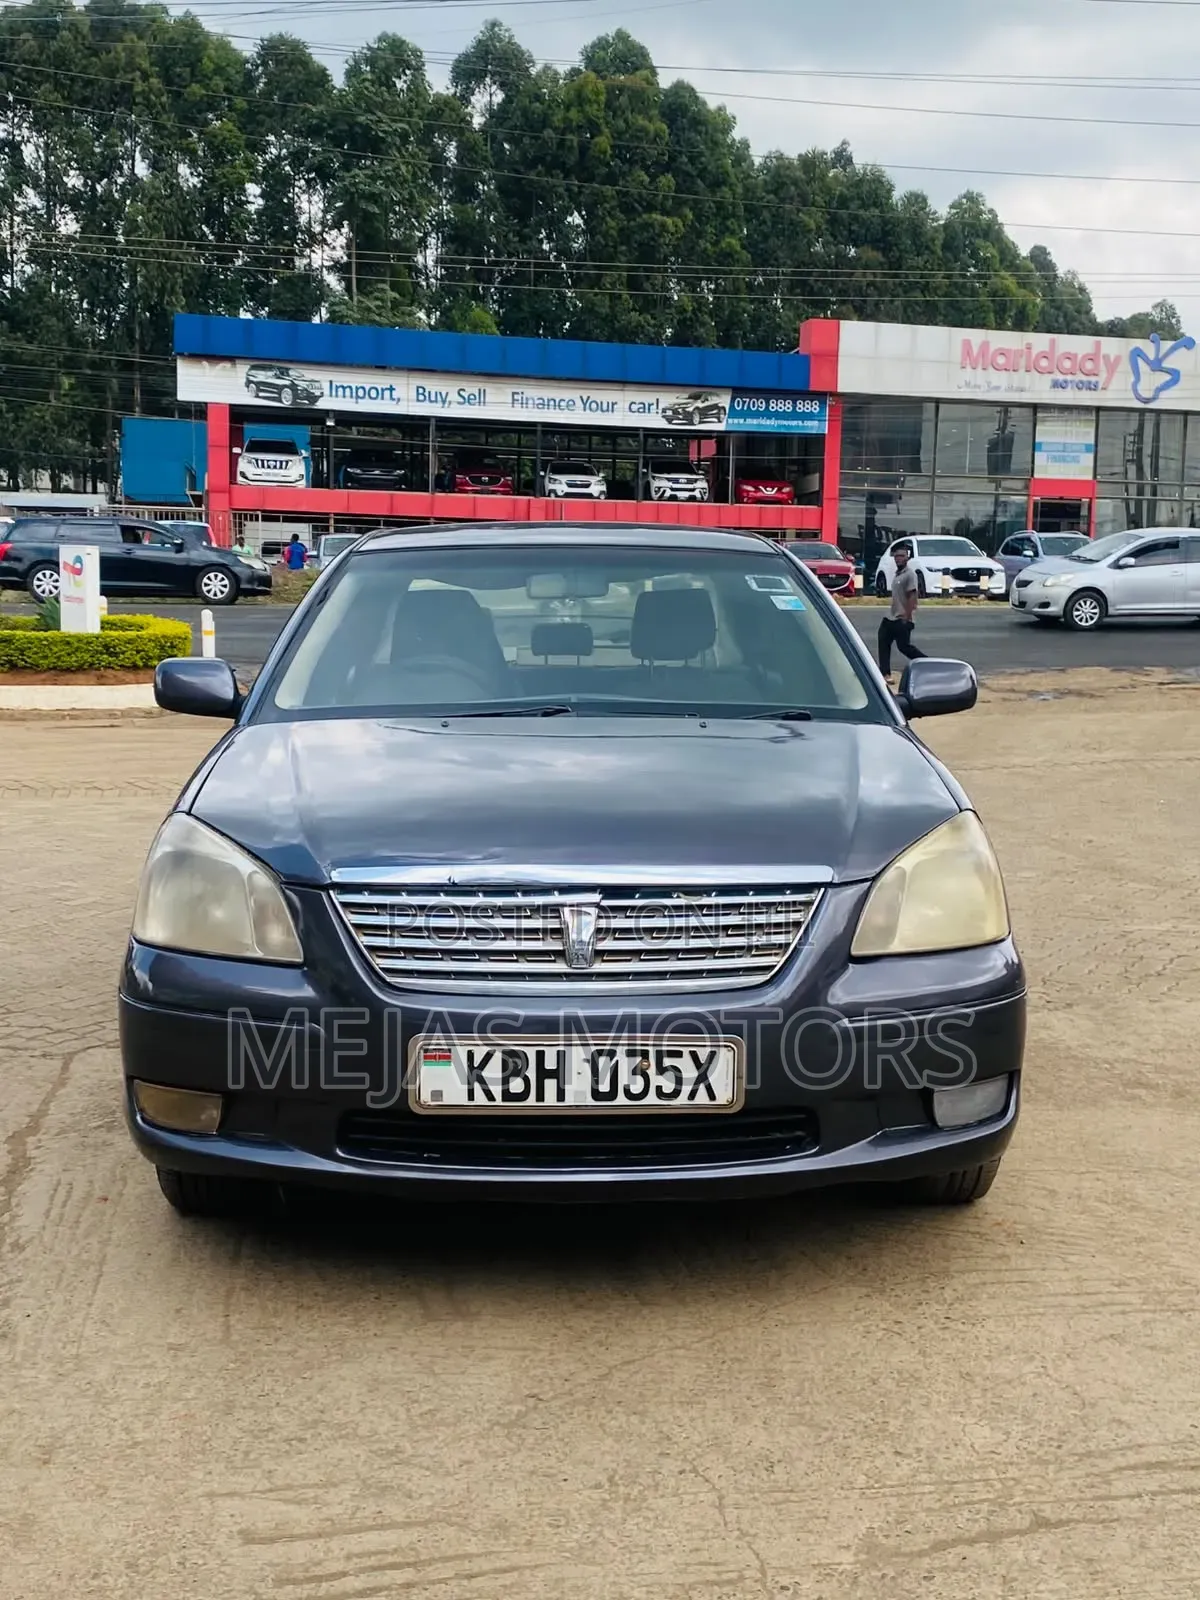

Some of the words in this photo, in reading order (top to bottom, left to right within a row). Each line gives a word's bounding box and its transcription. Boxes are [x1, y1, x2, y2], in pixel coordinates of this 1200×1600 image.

[960, 338, 1122, 391] Maridady
[328, 379, 401, 404] Import,
[415, 386, 451, 408] Buy,
[457, 388, 487, 406] Sell
[511, 391, 576, 412] Finance
[580, 395, 618, 414] Your
[628, 397, 660, 415] car!
[1050, 378, 1100, 392] MOTORS
[734, 398, 766, 411] 0709
[768, 399, 793, 412] 888
[796, 400, 820, 413] 888
[466, 1049, 566, 1102] KBH
[590, 1049, 717, 1101] 035X
